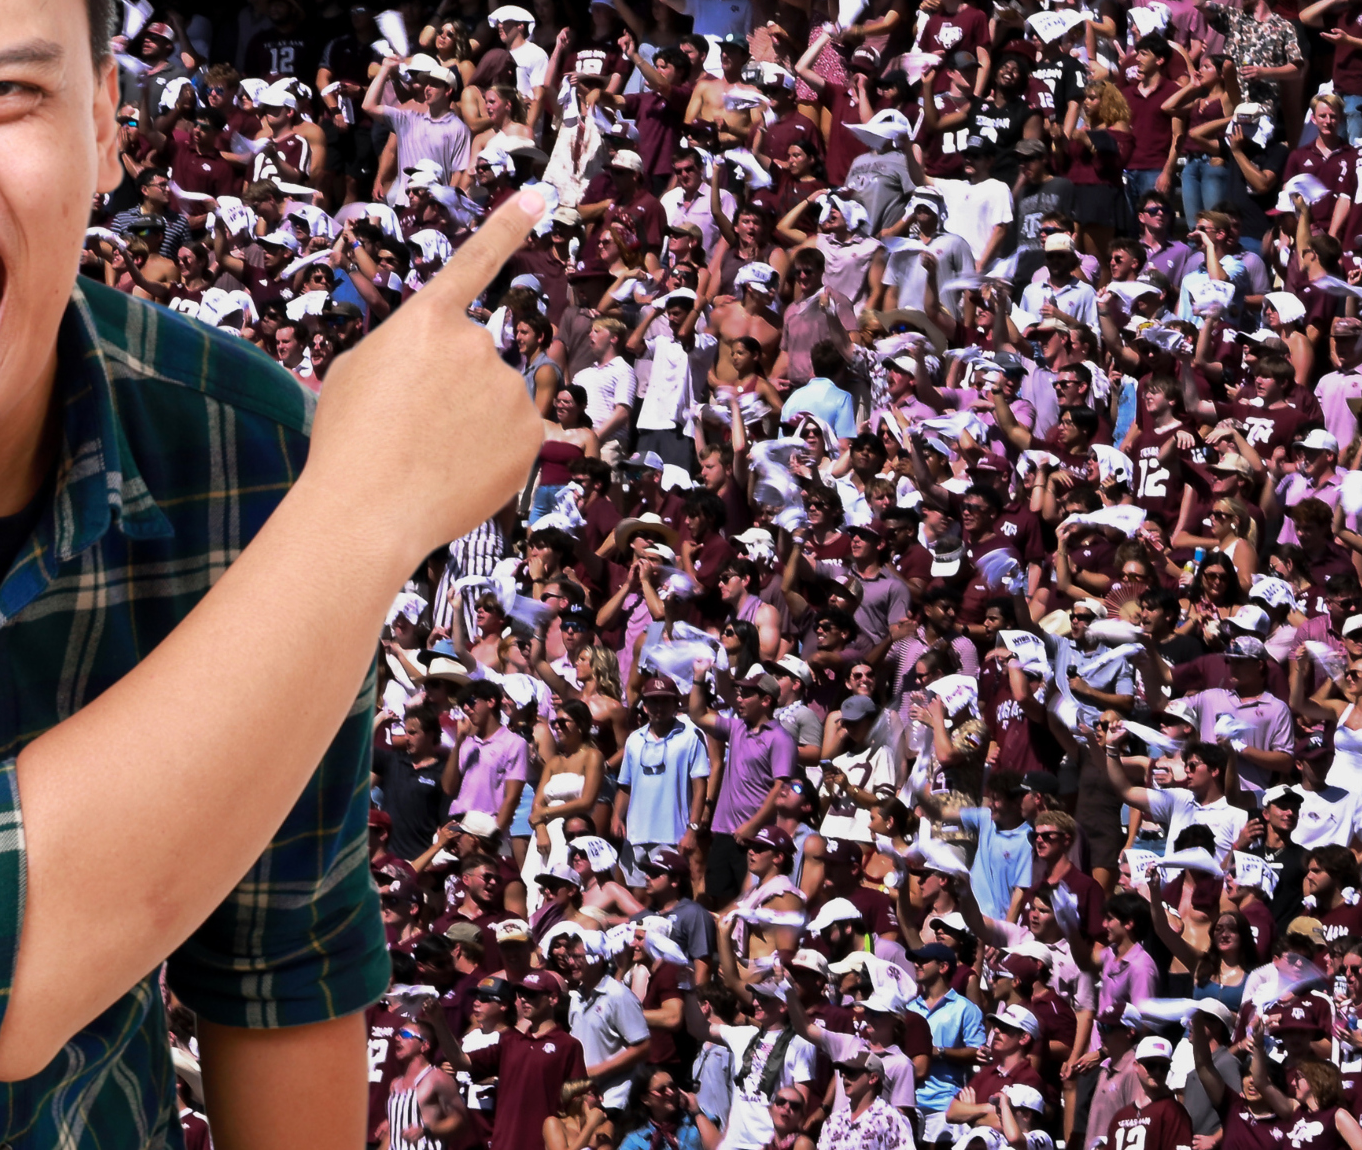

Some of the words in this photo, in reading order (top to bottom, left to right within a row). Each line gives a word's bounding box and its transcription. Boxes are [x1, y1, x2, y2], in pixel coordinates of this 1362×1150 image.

[270, 45, 293, 74] 12
[1037, 91, 1053, 106] 12
[1138, 458, 1169, 498] 12
